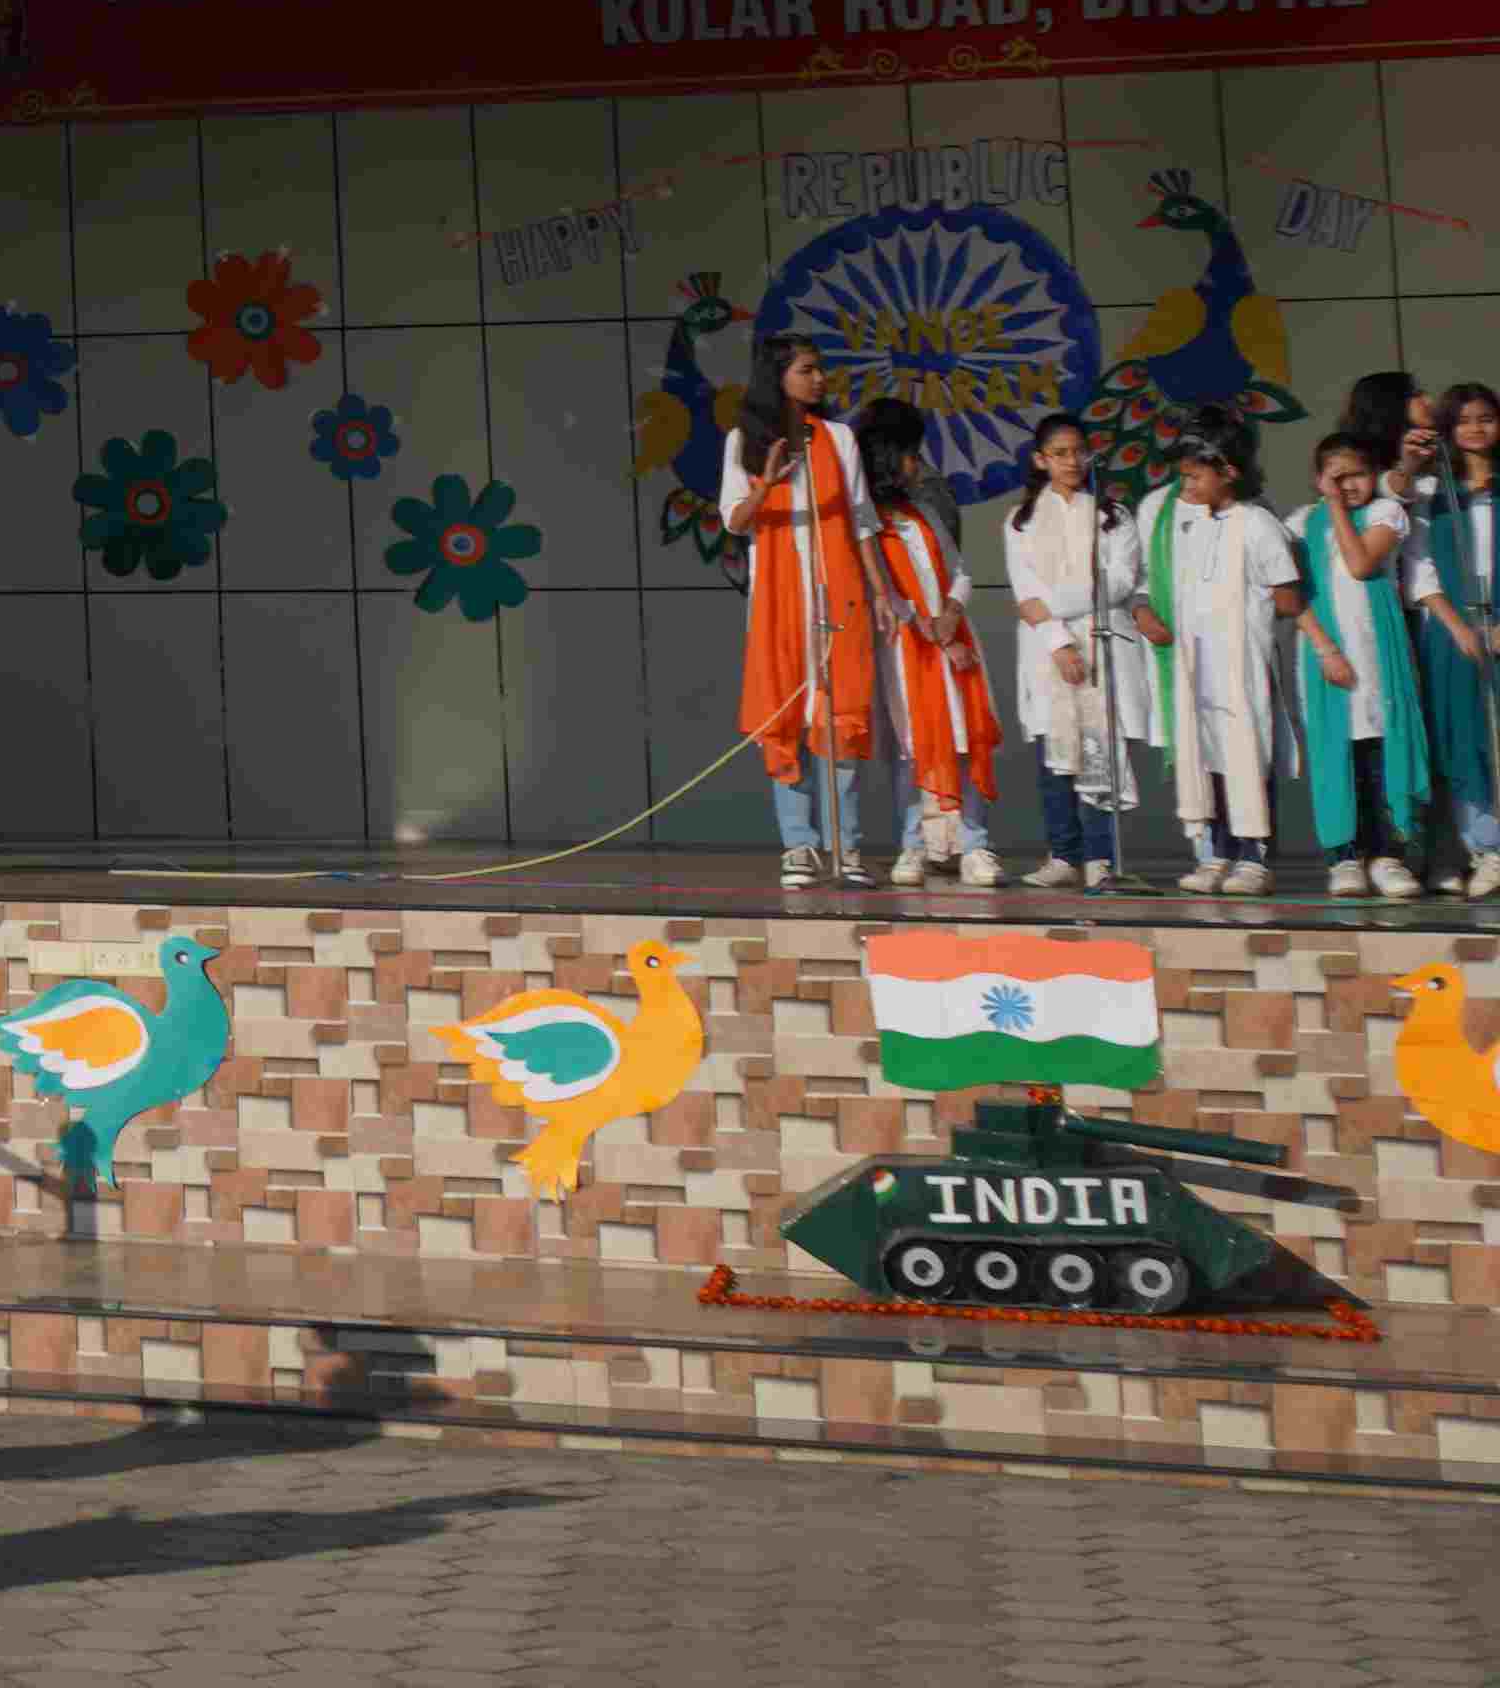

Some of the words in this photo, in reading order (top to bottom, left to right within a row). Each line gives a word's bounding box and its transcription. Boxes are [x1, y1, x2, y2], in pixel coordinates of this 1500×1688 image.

[494, 200, 638, 287] HAPPY
[779, 137, 1067, 216] REPUBLIC
[1276, 183, 1375, 250] DAY
[837, 303, 1011, 355] VANDE
[925, 1175, 1150, 1226] INDIA
